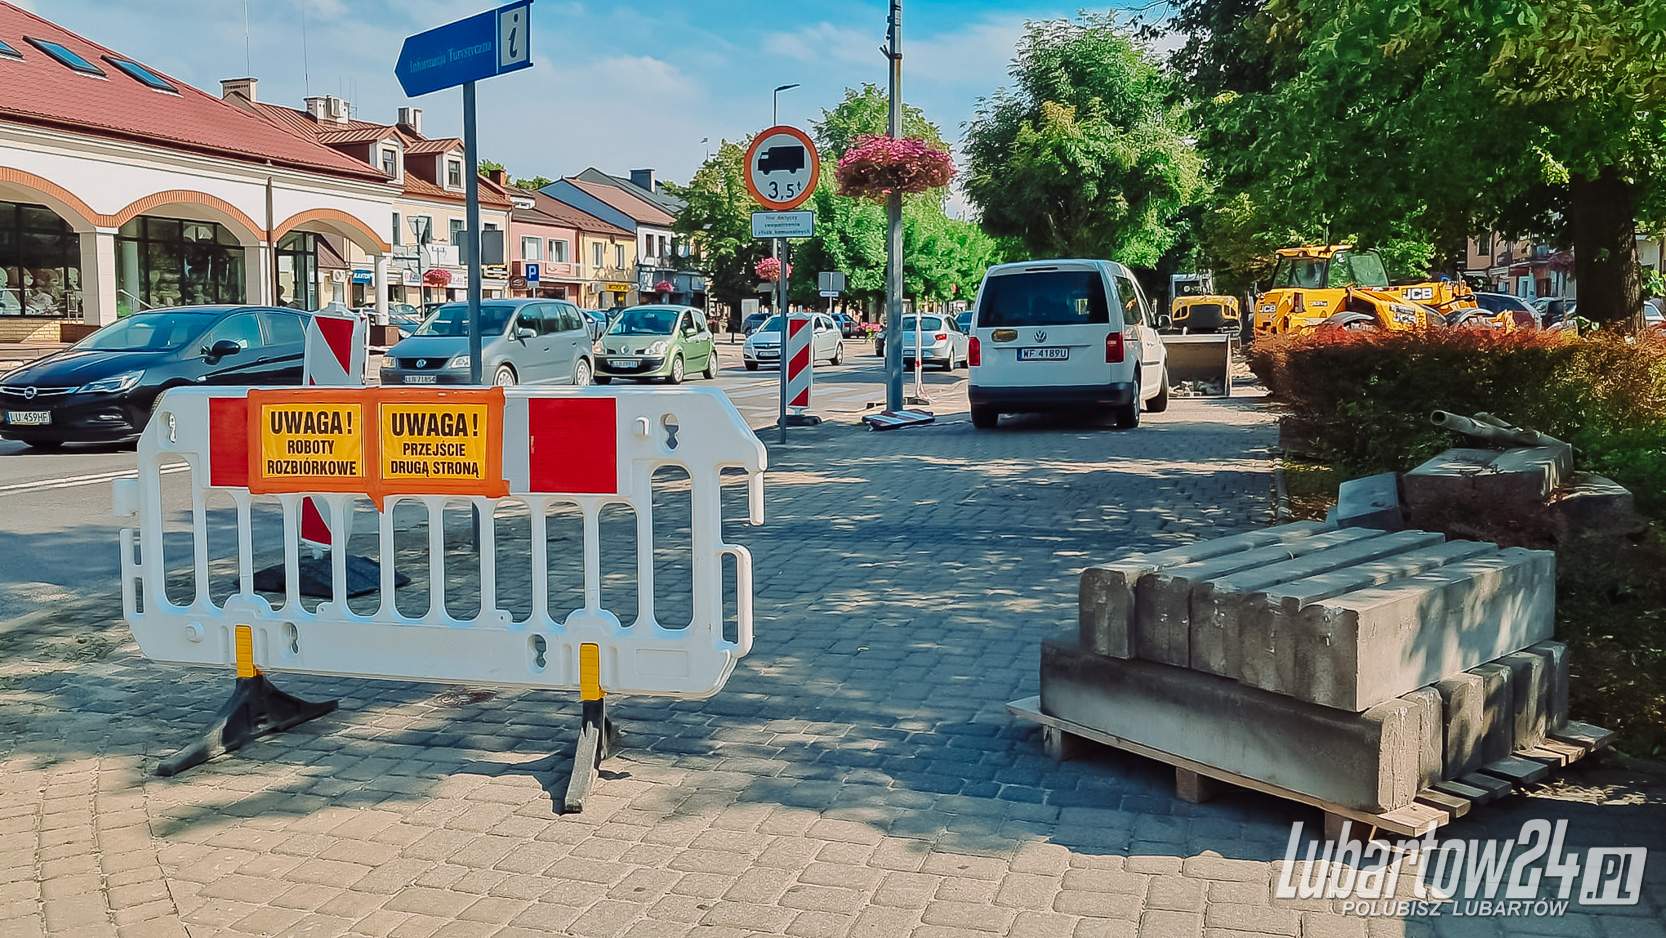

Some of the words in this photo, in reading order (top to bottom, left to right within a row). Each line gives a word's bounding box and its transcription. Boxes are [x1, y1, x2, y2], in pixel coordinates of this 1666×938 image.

[528, 265, 537, 279] P
[1402, 287, 1434, 300] JCB
[1259, 304, 1276, 313] JCB
[1038, 349, 1067, 358] 4189U
[11, 413, 21, 422] LU
[287, 439, 335, 455] ROBOTY
[402, 440, 466, 457] PRZEJŚCIE
[267, 457, 357, 476] ROZBIÓRKOWE
[390, 460, 430, 478] DRUGĄ
[432, 461, 480, 479] STRONĄ
